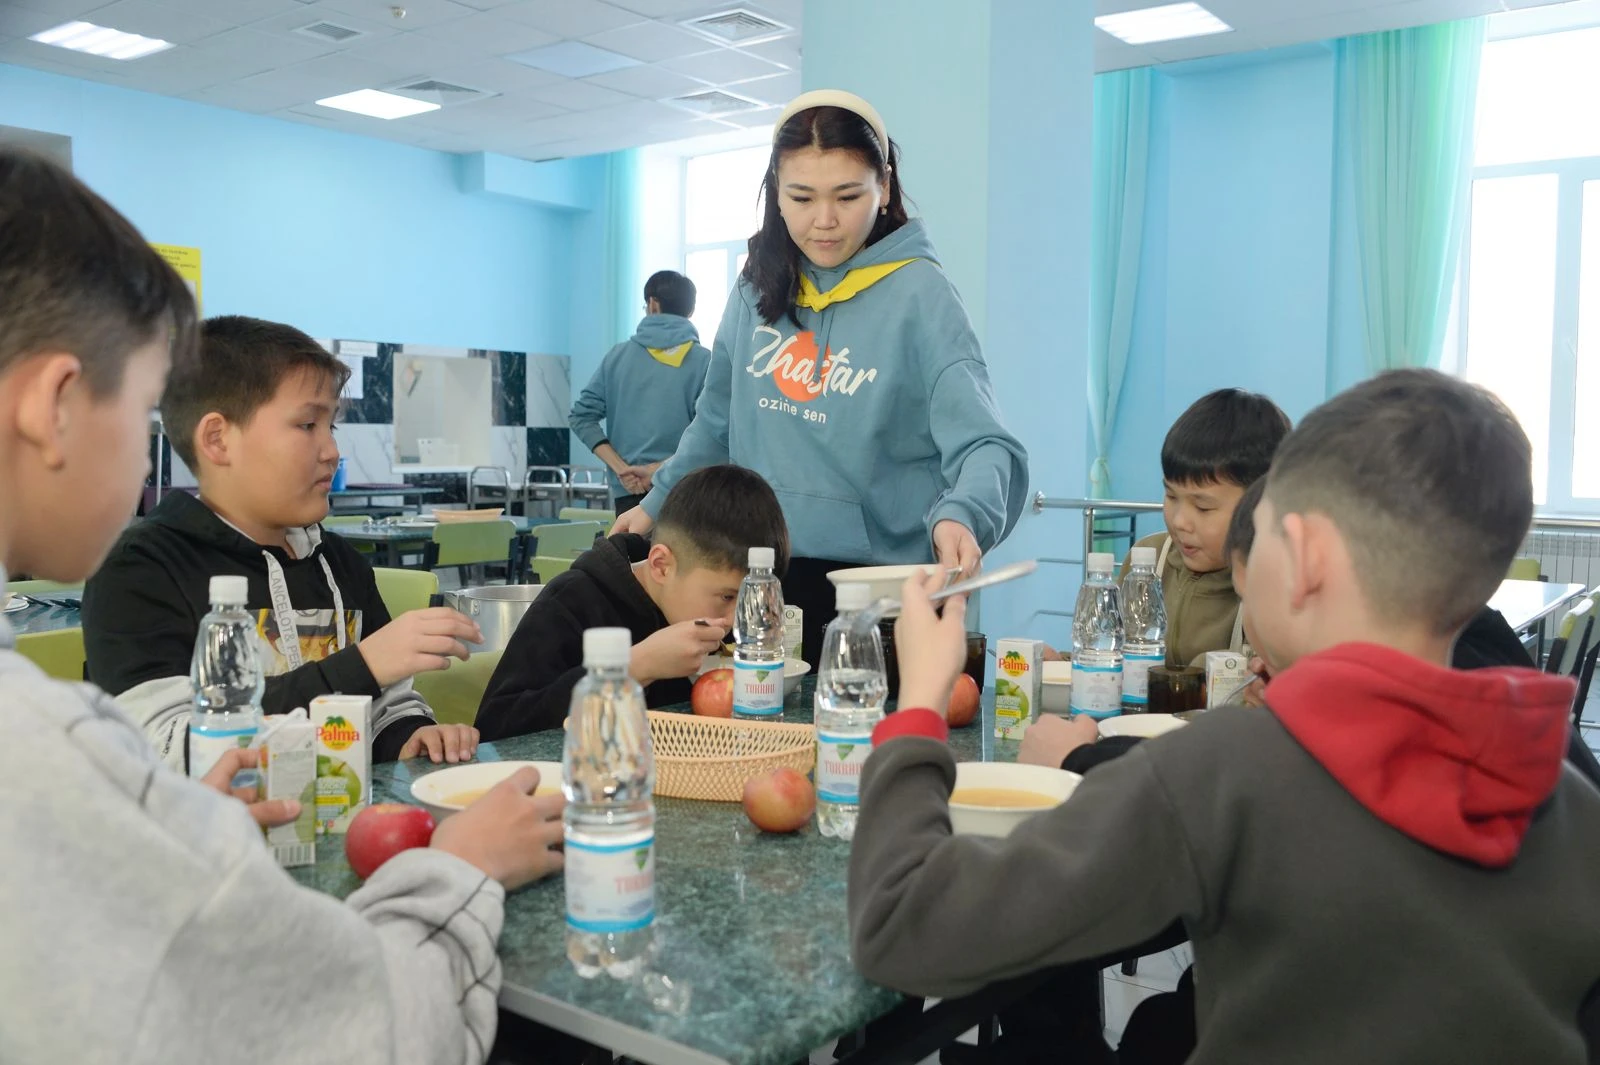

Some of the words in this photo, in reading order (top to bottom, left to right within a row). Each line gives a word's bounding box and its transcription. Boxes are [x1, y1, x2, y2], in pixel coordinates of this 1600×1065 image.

[802, 408, 826, 424] sen
[999, 658, 1030, 671] Palma
[315, 726, 361, 742] Palma
